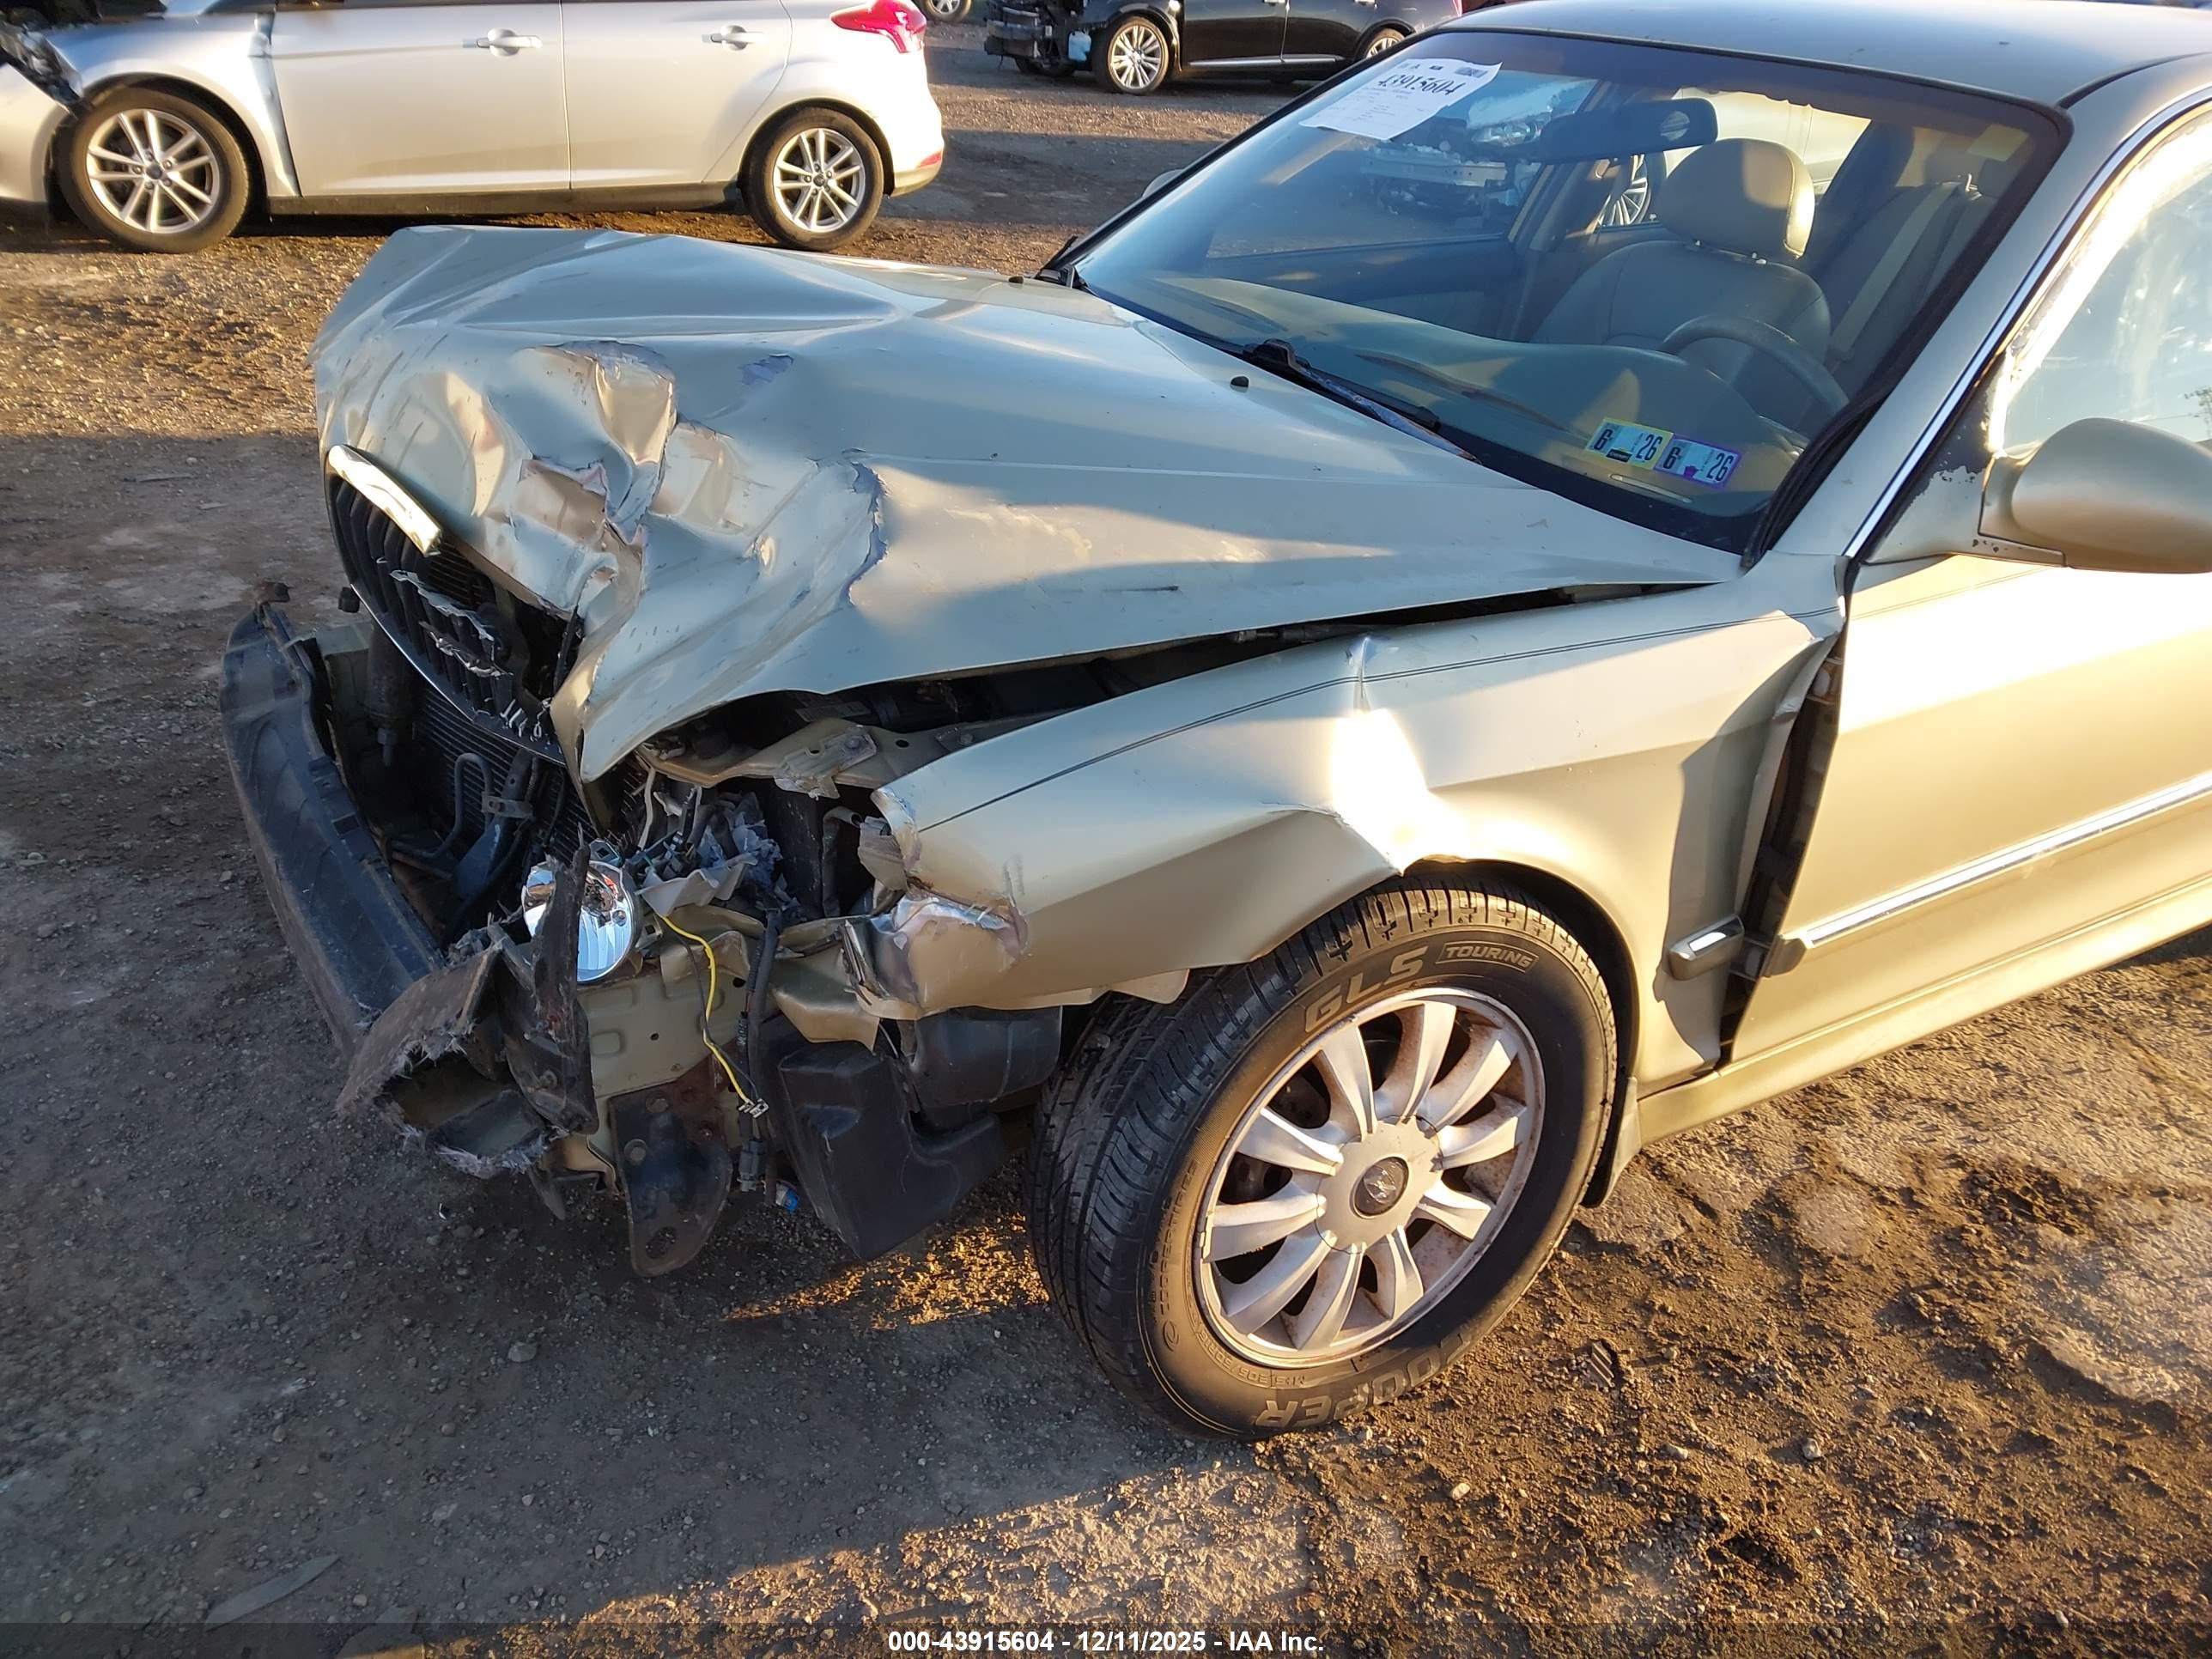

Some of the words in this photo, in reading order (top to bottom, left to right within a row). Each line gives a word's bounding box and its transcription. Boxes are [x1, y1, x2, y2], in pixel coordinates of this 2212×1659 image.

[1377, 73, 1467, 96] 43915604
[1593, 428, 1614, 451] 6
[1635, 434, 1663, 461] 26
[1662, 447, 1681, 470] 6
[1705, 453, 1735, 482] 26
[1444, 945, 1534, 968] TOURING
